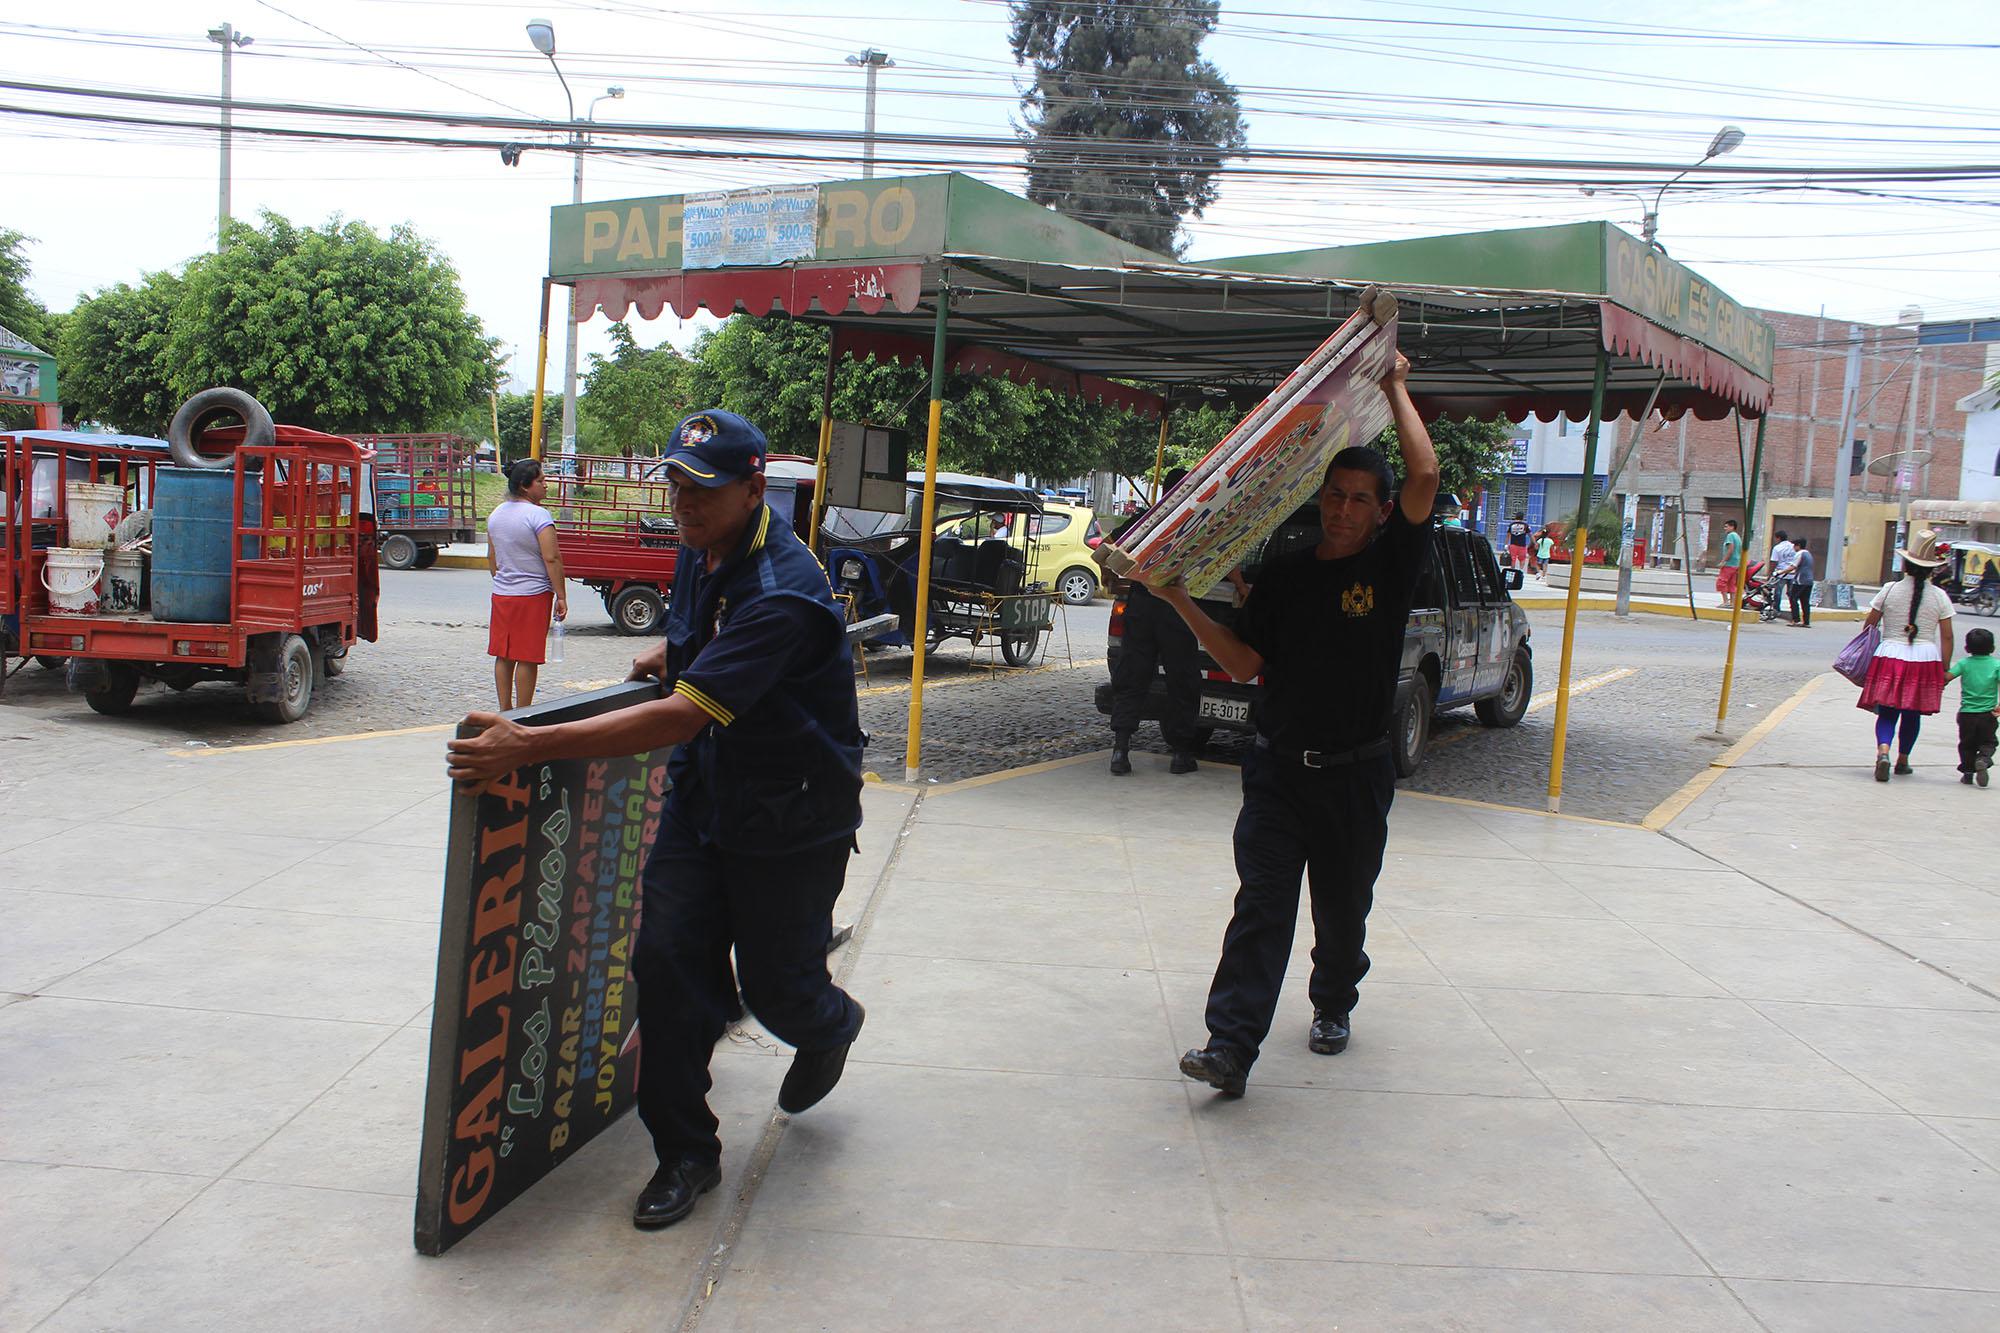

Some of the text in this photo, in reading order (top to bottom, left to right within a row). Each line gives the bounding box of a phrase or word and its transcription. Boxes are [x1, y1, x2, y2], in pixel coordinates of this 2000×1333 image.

[696, 206, 725, 221] WALDO
[741, 202, 769, 216] WALDO
[786, 197, 816, 212] WALDO
[1617, 239, 1681, 321] CASMA
[1688, 279, 1711, 335] ES
[1014, 599, 1047, 625] STOP
[579, 776, 628, 1081] PERFUMERIA
[449, 767, 532, 1225] GALERIA
